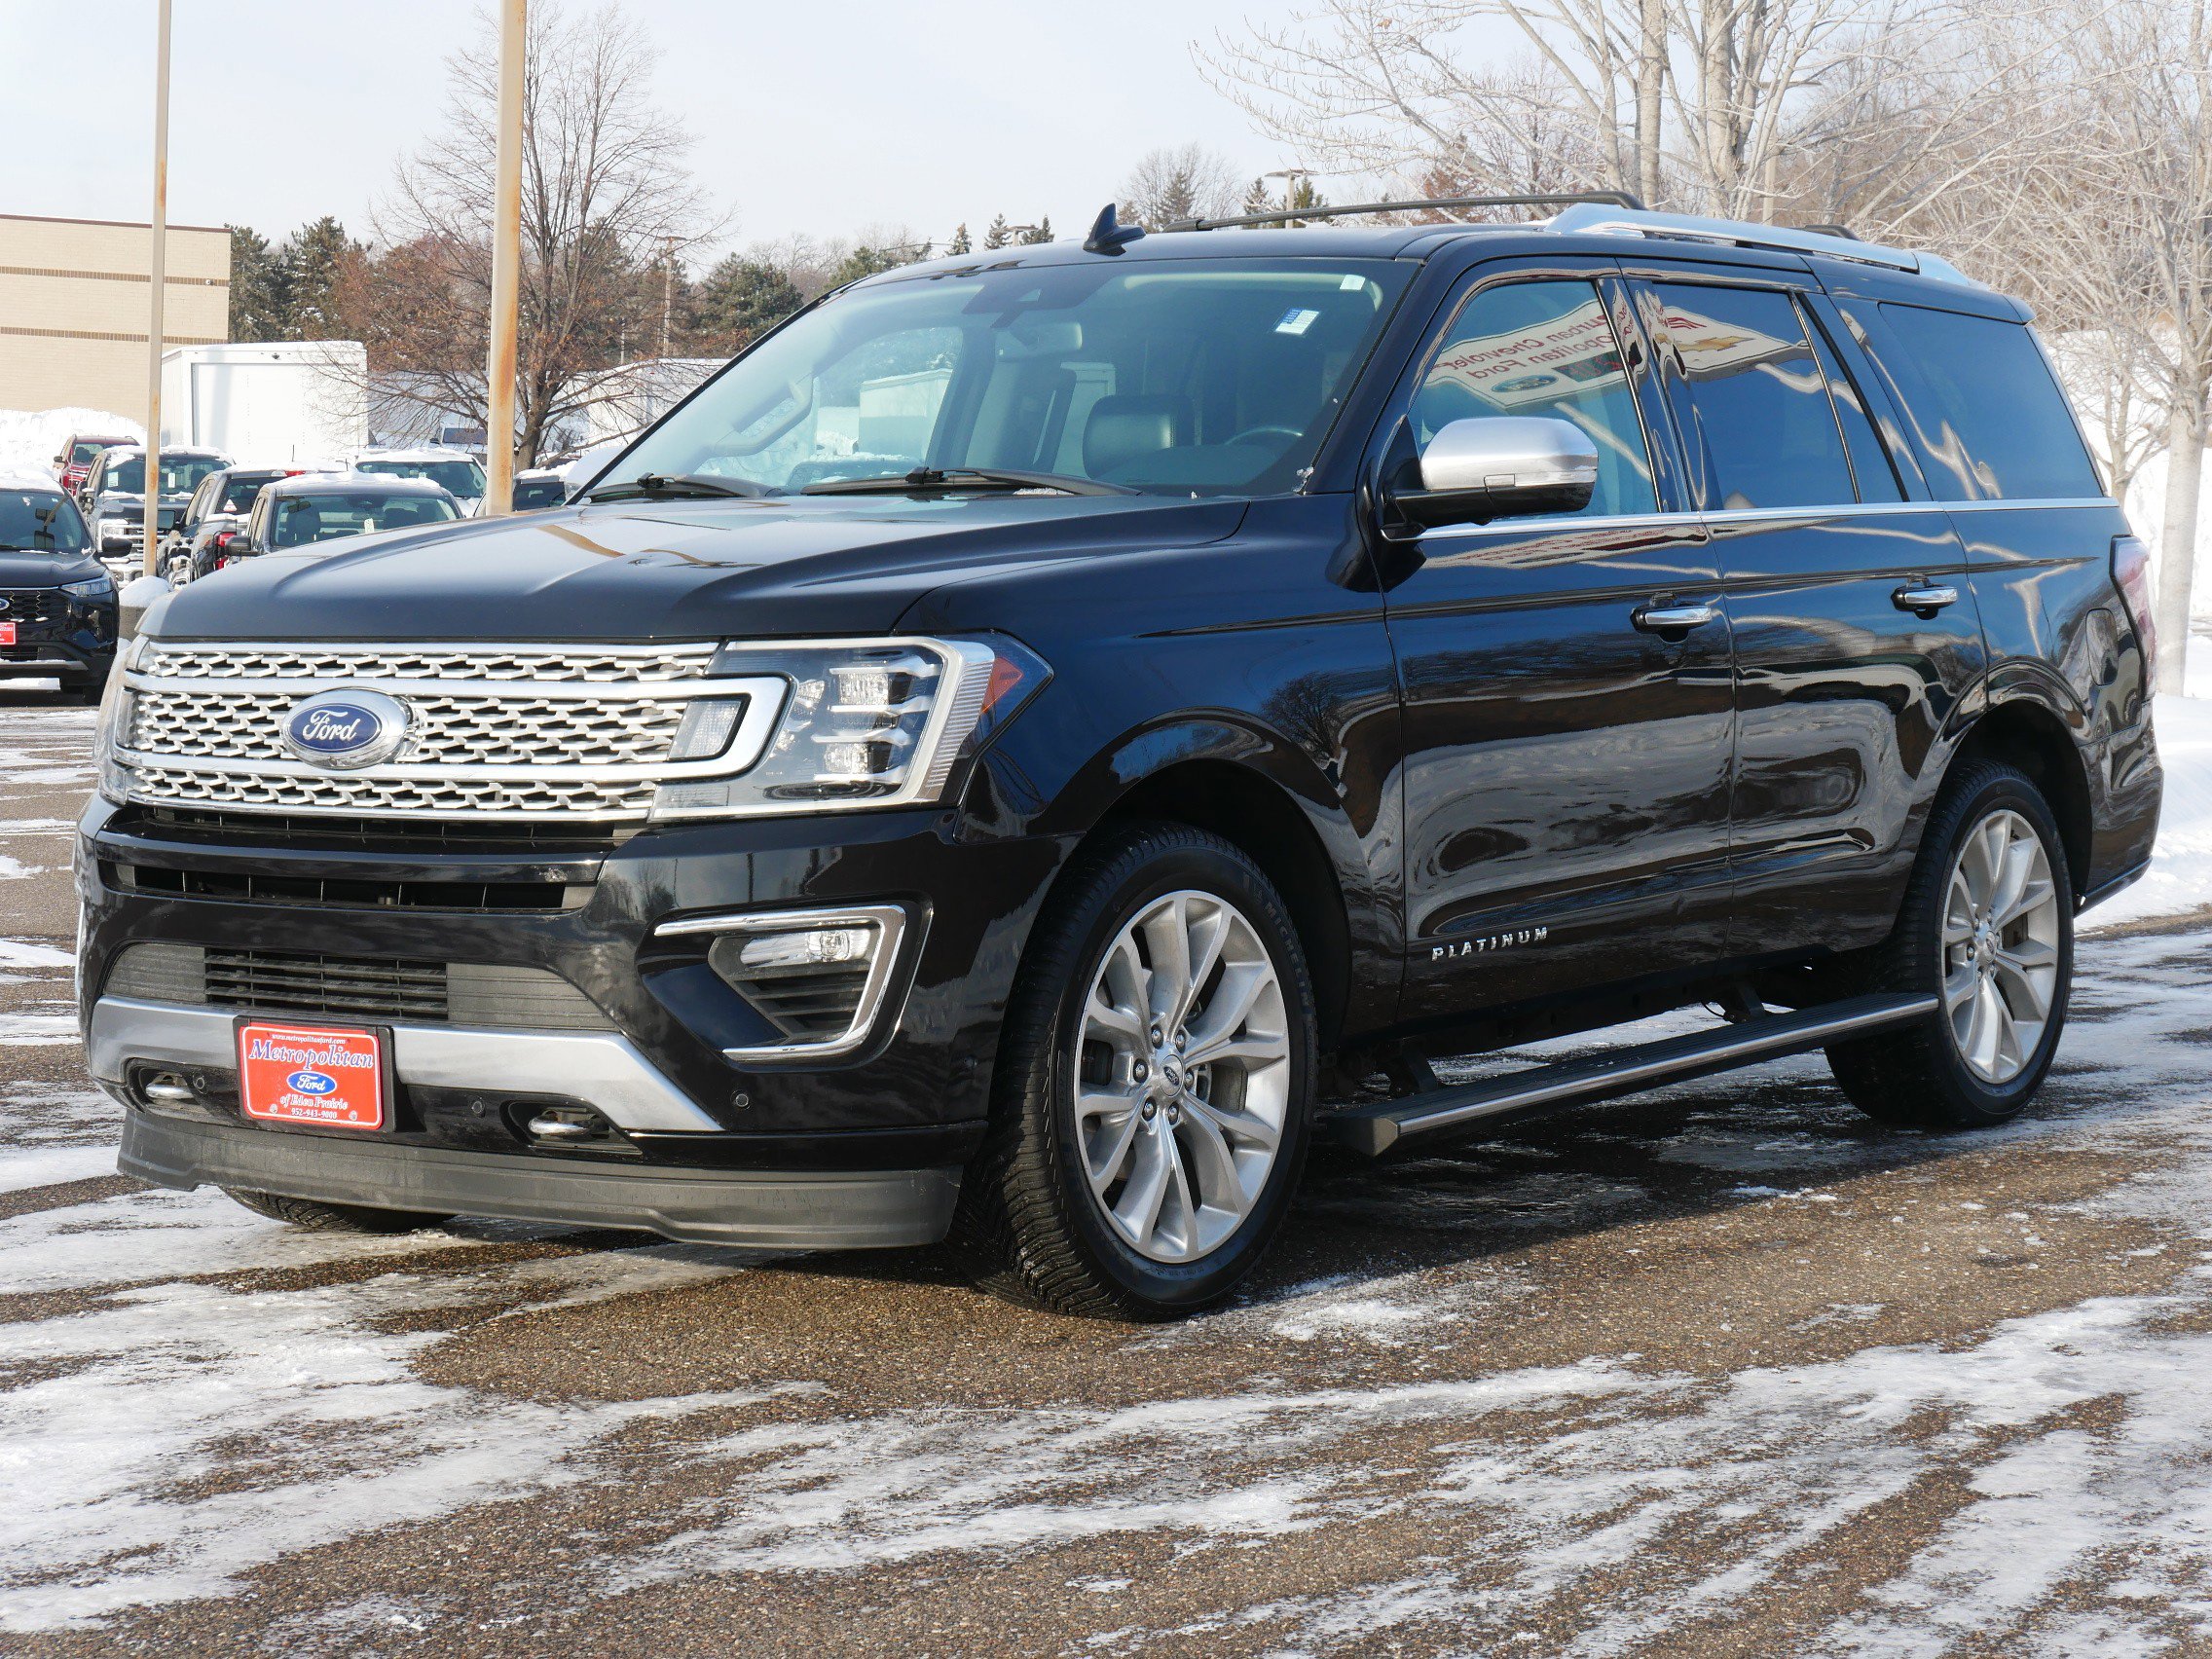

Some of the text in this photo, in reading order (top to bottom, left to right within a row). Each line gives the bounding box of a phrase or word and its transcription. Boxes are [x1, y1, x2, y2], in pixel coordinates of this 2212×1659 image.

[302, 709, 361, 742] Ford
[1431, 926, 1549, 963] PLATINUM
[248, 1038, 374, 1071] Metropolitan
[297, 1074, 326, 1090] Ford
[279, 1093, 349, 1110] of Eden Prairie
